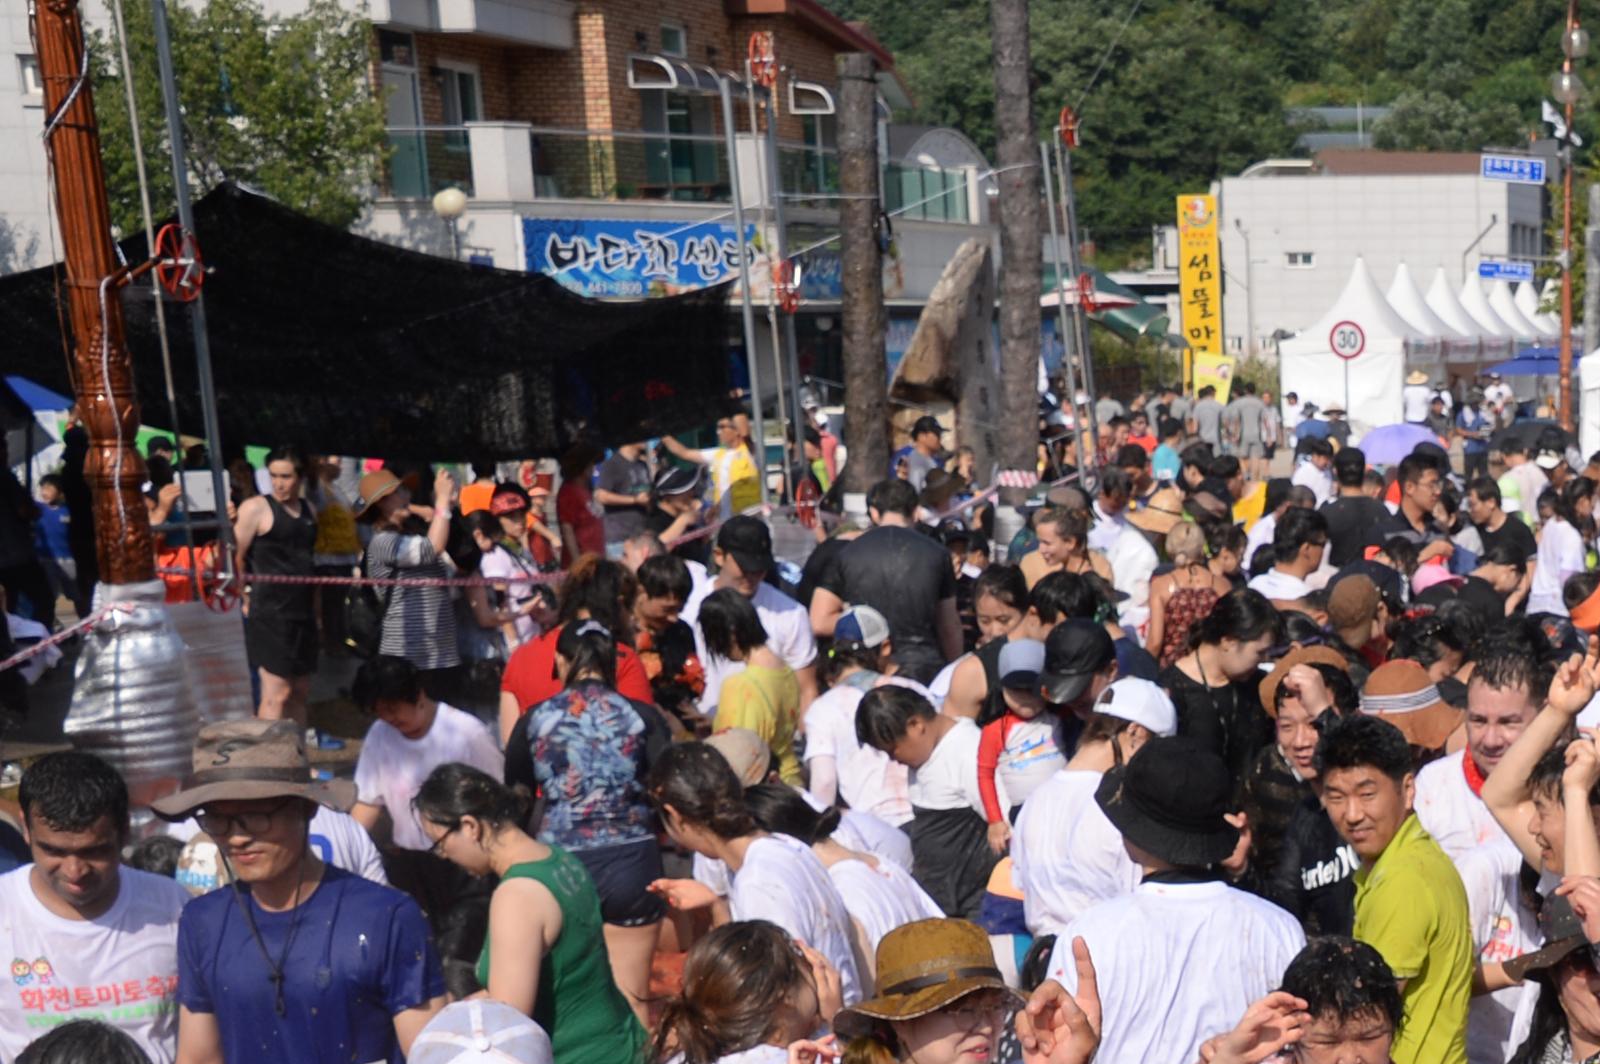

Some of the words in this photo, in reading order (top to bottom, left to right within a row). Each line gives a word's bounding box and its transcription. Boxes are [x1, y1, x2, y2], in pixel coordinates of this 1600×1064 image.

[1187, 253, 1215, 351] 섬뜰마
[1337, 329, 1358, 349] 30
[1301, 857, 1340, 890] urley
